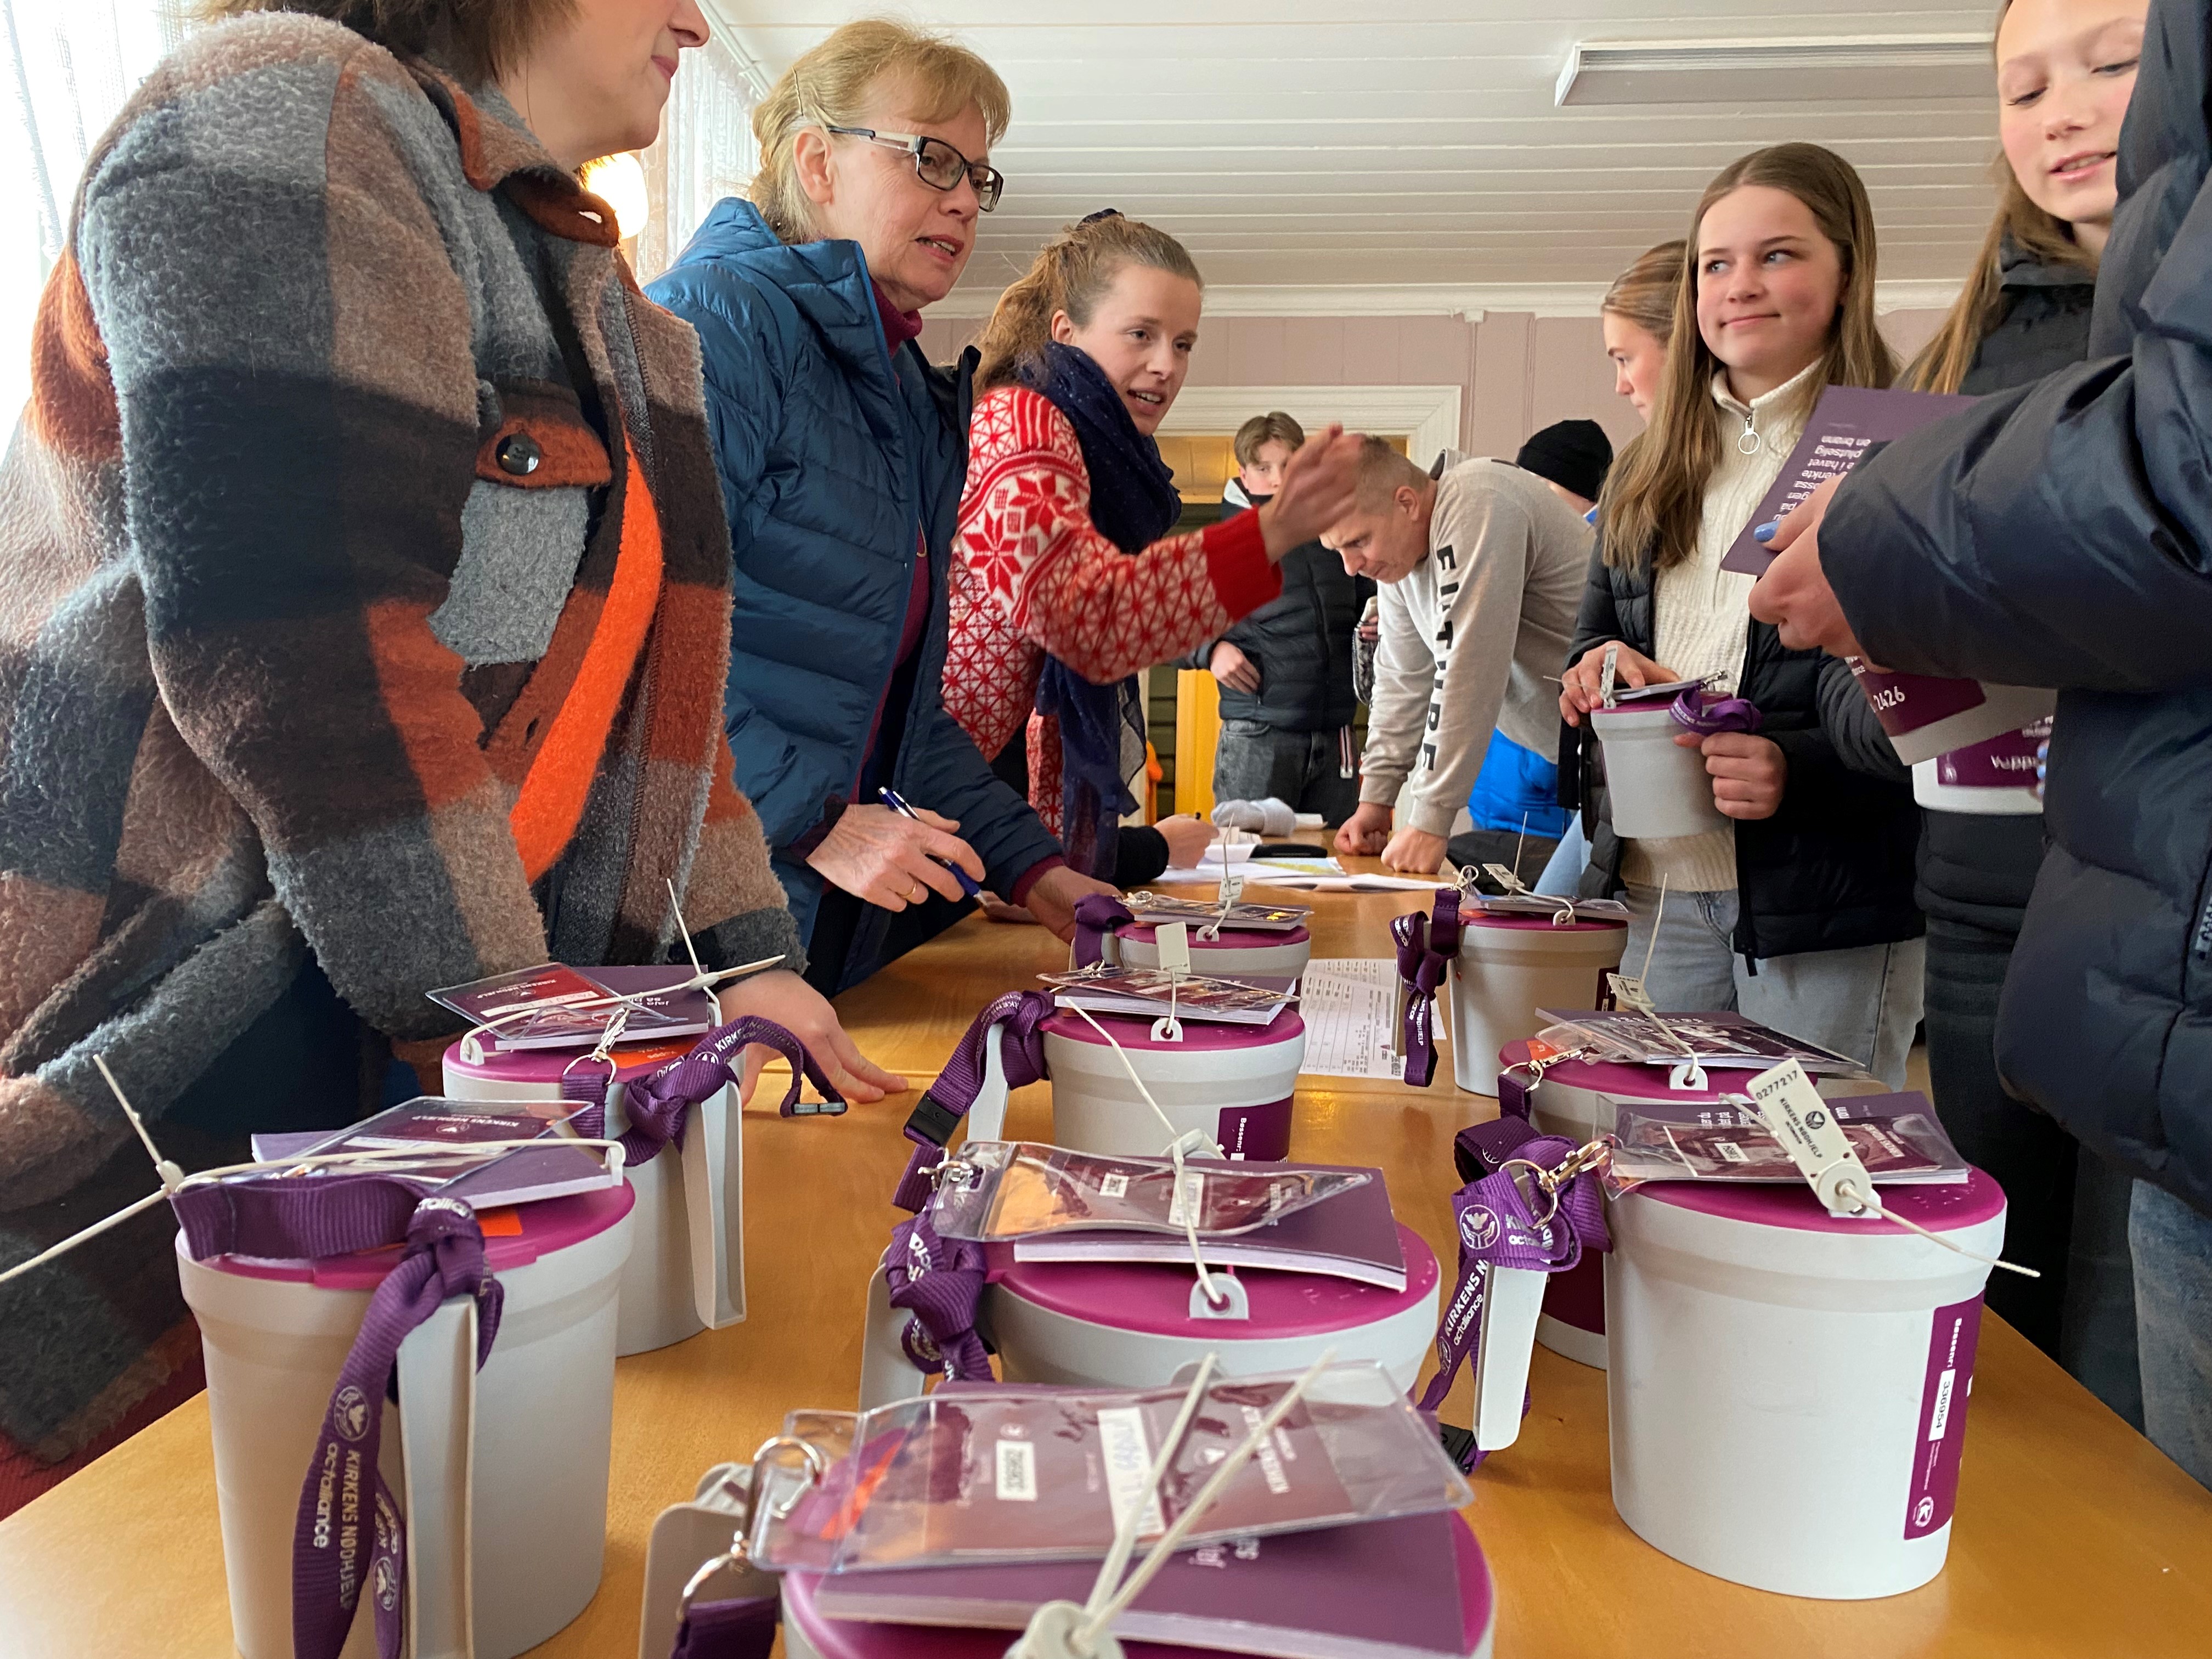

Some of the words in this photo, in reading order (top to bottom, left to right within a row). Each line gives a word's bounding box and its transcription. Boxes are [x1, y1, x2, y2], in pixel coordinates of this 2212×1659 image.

[1808, 458, 1839, 470] havet
[1815, 445, 1864, 460] plutselig
[1423, 544, 1459, 771] FITURE
[1873, 686, 1905, 710] 2426
[1756, 1070, 1797, 1100] 0277217
[470, 1118, 520, 1127] KIRKENS
[1236, 1118, 1247, 1152] Bøssenr:
[1780, 1098, 1801, 1127] KIRKENS
[1798, 1126, 1823, 1158] NØDHJELP
[1444, 1272, 1481, 1337] KIRKENS
[1454, 1294, 1483, 1346] actalliance
[1936, 1380, 1951, 1429] 336954
[313, 1442, 339, 1548] actalliance
[342, 1449, 361, 1522] KIRKENS
[340, 1525, 359, 1610] NØDHJELP
